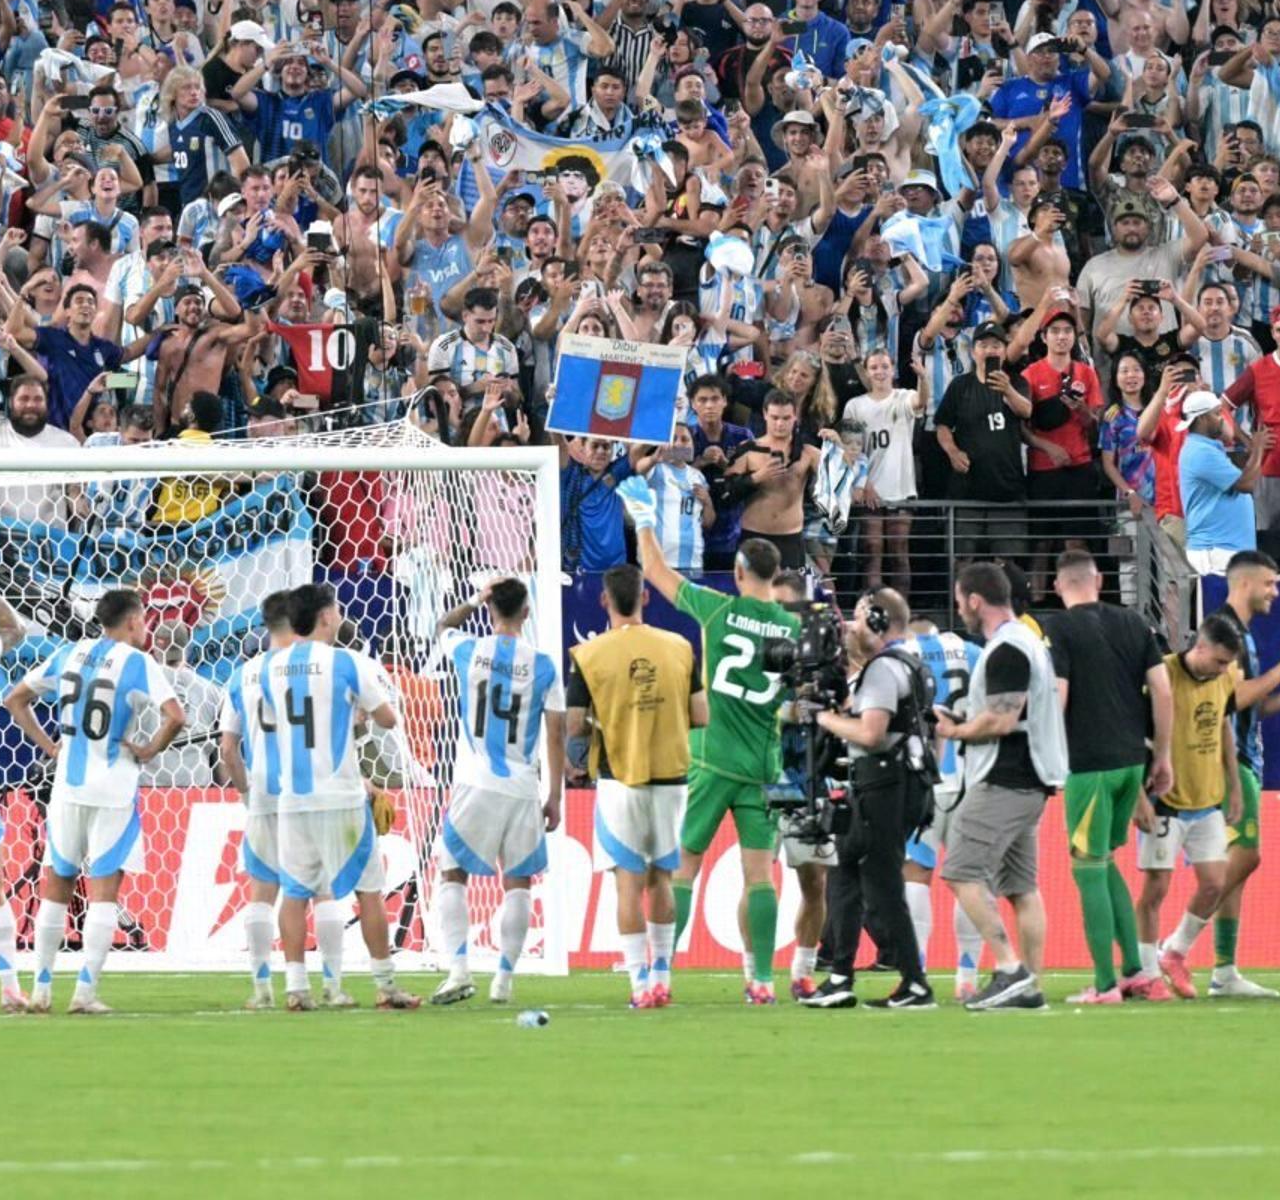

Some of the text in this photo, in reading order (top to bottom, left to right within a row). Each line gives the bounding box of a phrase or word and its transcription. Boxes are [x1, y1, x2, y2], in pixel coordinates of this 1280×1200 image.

[283, 120, 302, 141] 10
[174, 150, 188, 166] 20
[431, 264, 461, 282] VISA
[307, 328, 355, 372] 10
[987, 412, 1005, 432] 19
[871, 429, 889, 451] 10
[680, 495, 695, 515] 10
[60, 671, 115, 741] 26
[474, 679, 522, 744] 14
[284, 686, 316, 749] 4
